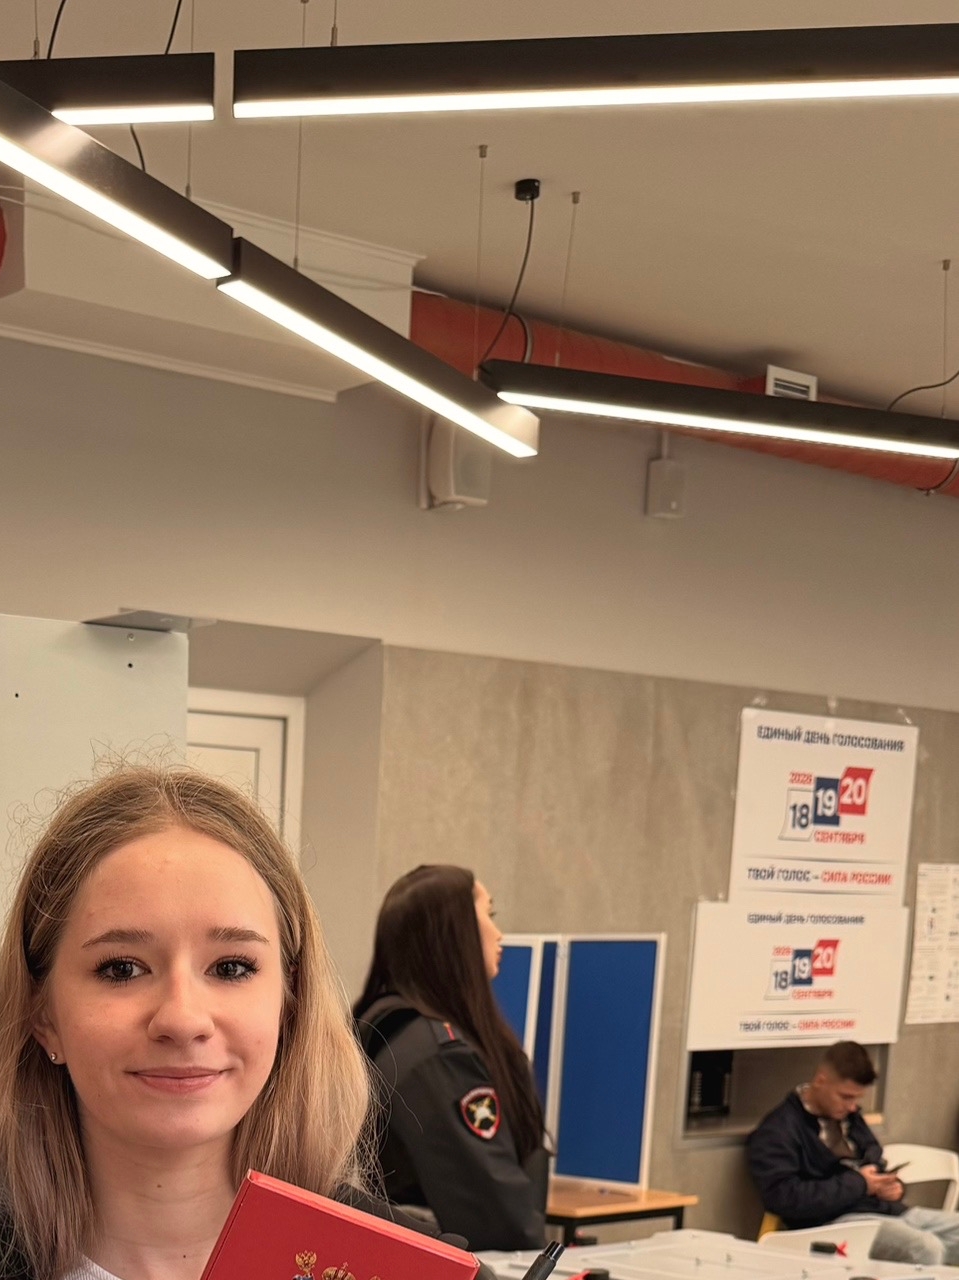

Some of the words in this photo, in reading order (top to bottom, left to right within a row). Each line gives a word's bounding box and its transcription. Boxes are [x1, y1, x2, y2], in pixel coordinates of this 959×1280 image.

[757, 725, 801, 741] ЕДИНЫЙ
[804, 731, 830, 744] ДЕНЬ
[832, 733, 904, 751] ГОЛОСОВАНИЯ
[790, 804, 810, 828] 18
[815, 788, 837, 816] 19
[841, 778, 866, 805] 20
[814, 831, 864, 844] СЕНТЯБРЯ
[748, 865, 775, 880] ТВОЙ
[777, 870, 810, 882] ГОЛОС
[821, 870, 847, 883] СИЛА
[806, 914, 864, 924] ГОЛОСОВАНИЯ
[773, 971, 789, 989] 18
[794, 957, 810, 979] 19
[813, 946, 833, 969] 20
